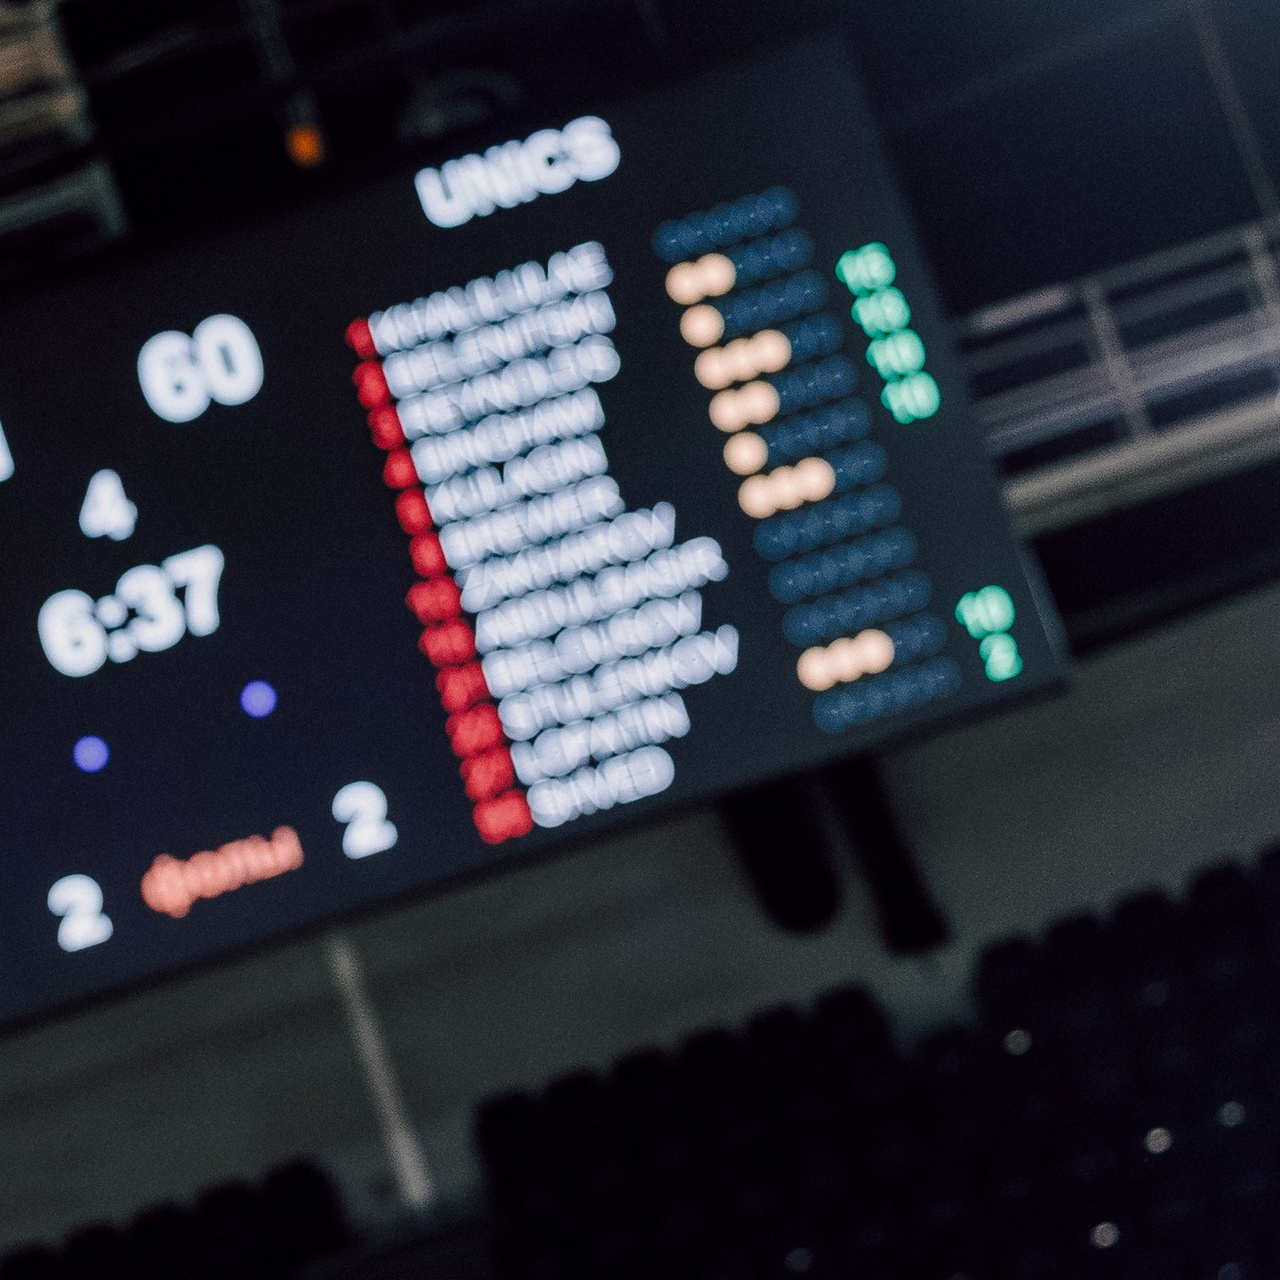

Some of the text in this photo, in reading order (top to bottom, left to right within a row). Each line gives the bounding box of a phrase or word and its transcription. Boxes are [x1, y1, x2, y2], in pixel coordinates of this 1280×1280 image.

[415, 116, 621, 228] UNICS
[137, 313, 265, 423] 60
[78, 469, 138, 541] 4
[37, 544, 225, 678] 6:37
[332, 780, 398, 859] 2
[47, 873, 113, 952] 2
